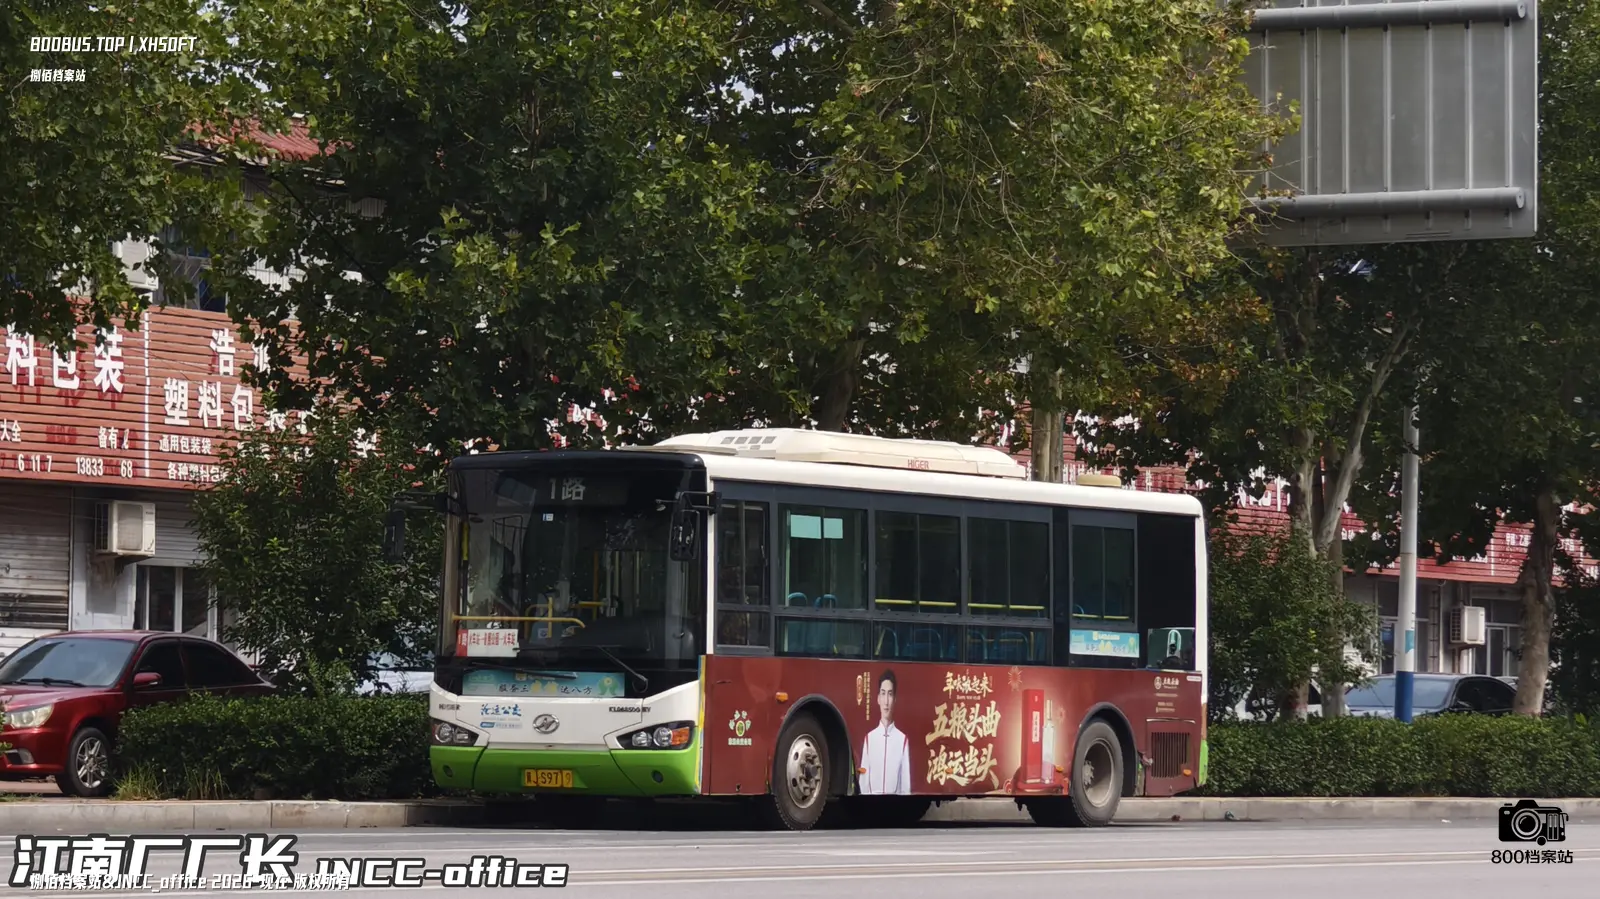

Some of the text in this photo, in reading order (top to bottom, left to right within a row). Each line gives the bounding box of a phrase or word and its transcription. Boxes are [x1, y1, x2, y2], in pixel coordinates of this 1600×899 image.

[1, 418, 22, 443] 大全
[159, 434, 212, 455] 通用包装袋
[76, 457, 104, 476] 13833
[120, 460, 134, 478] 68
[907, 459, 930, 470] HIGER
[925, 700, 1002, 746] 五粮头曲
[925, 743, 1000, 791] 鸿运当头
